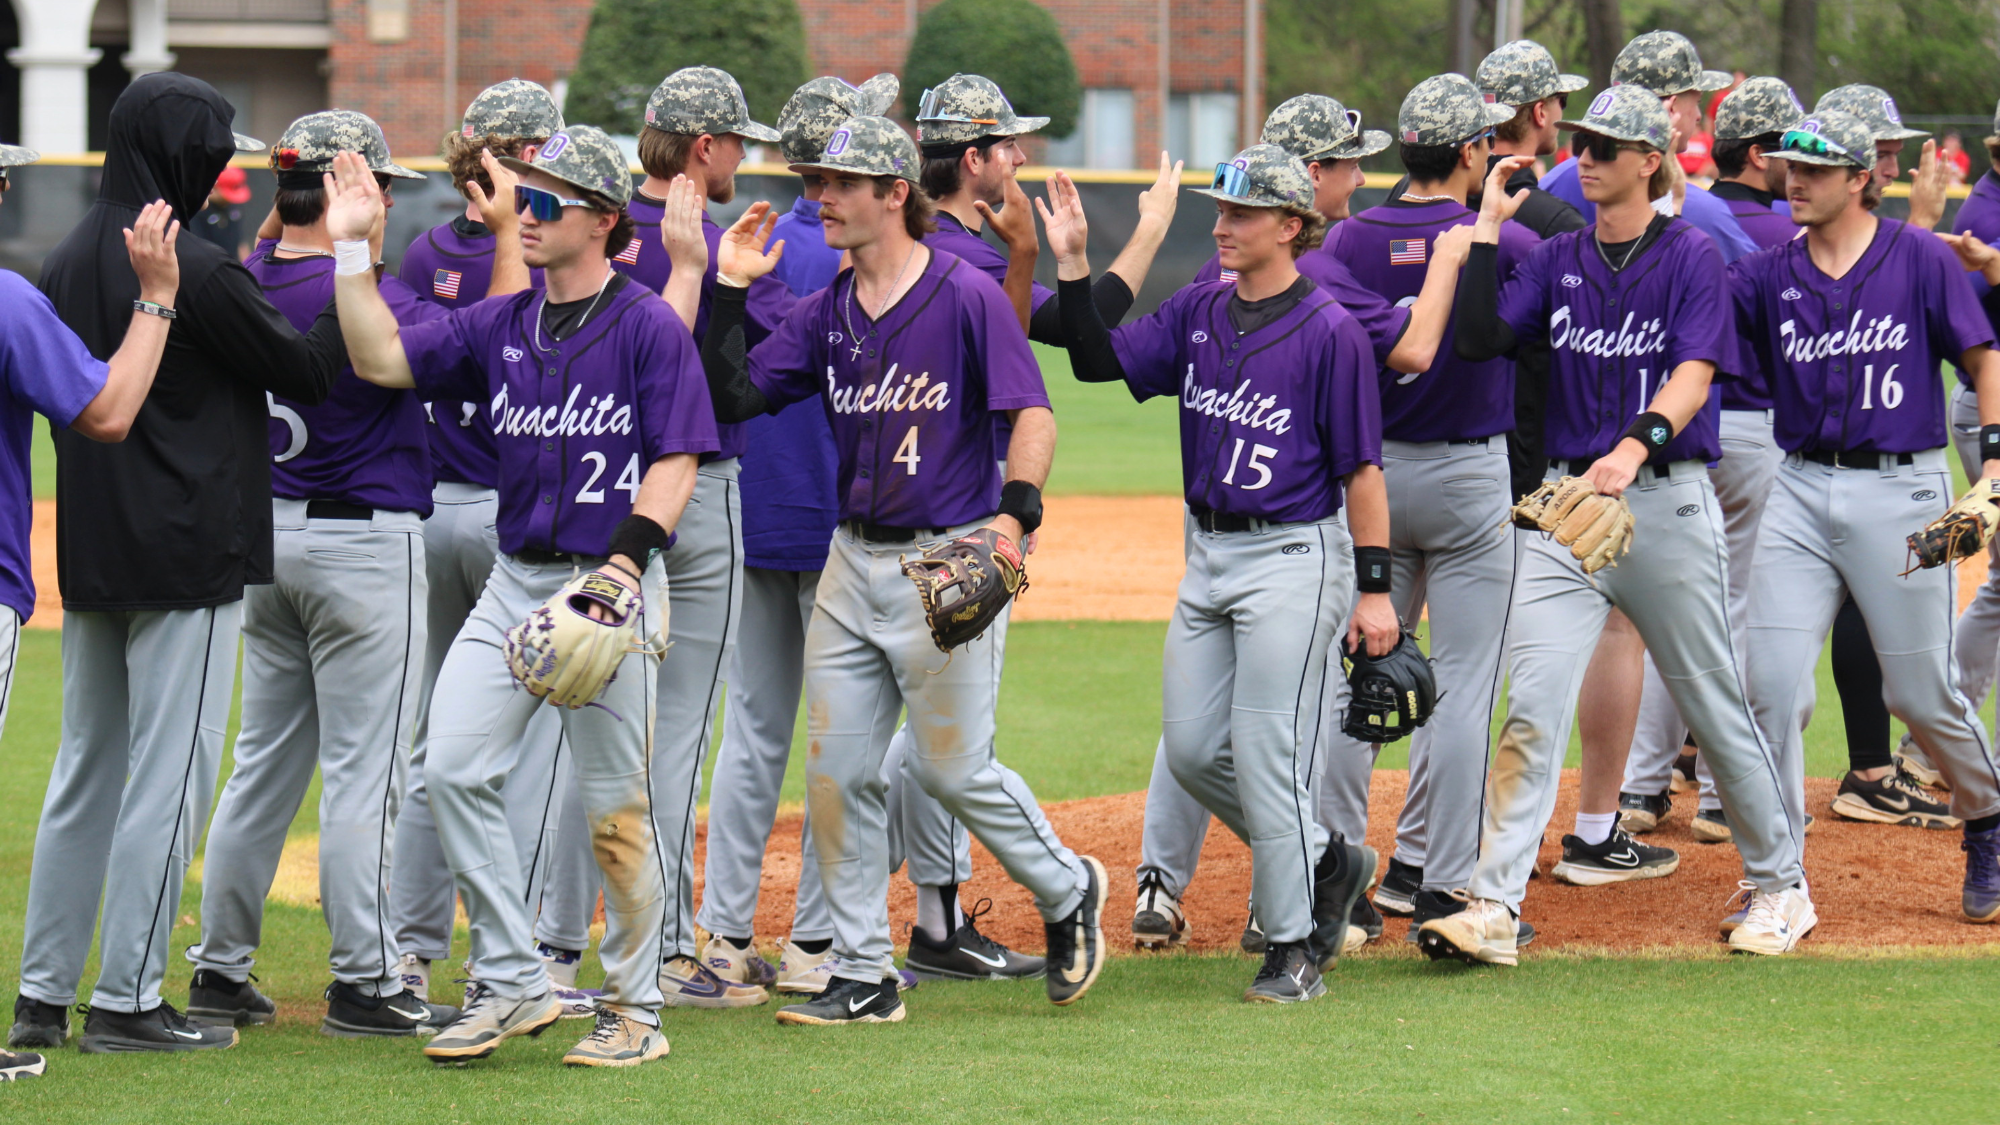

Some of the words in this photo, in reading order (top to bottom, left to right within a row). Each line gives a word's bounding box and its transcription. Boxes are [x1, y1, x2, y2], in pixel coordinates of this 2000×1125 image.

[1779, 309, 1910, 363] Ouachita
[491, 382, 633, 437] Ouachita
[827, 362, 951, 415] Ouchita
[1184, 362, 1292, 436] Ouachita
[1861, 363, 1904, 410] 16
[575, 450, 642, 504] 24
[892, 425, 922, 476] 4
[1221, 437, 1279, 490] 15
[1554, 486, 1578, 512] A2000
